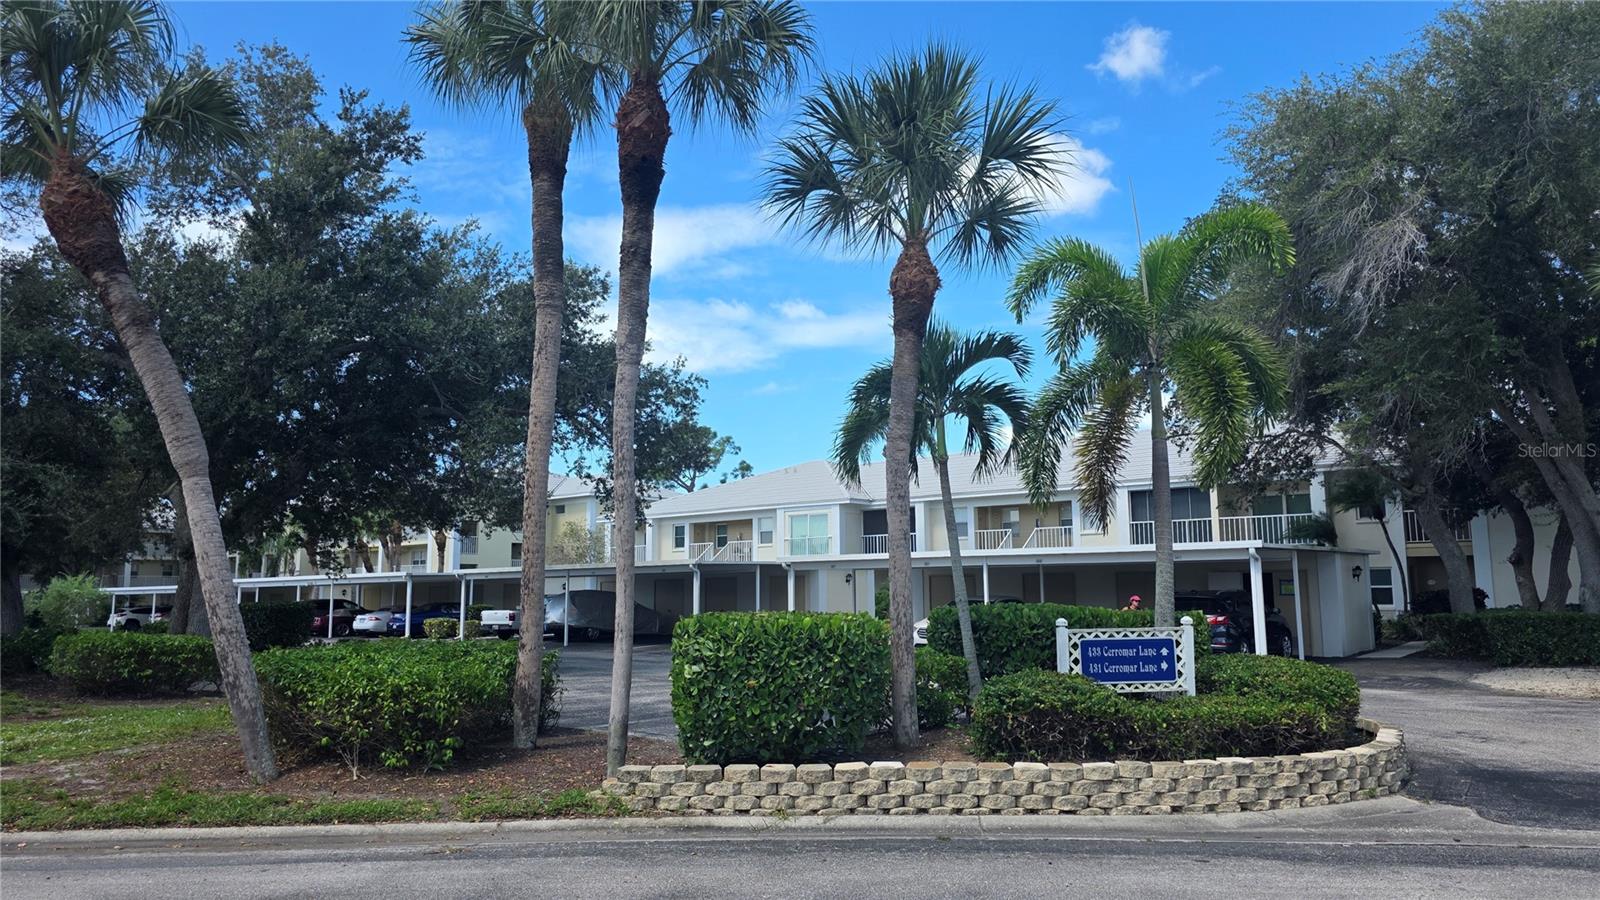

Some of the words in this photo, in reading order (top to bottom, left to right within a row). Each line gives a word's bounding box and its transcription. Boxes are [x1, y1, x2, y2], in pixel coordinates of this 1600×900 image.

[1103, 646, 1136, 658] Cerromar
[1139, 645, 1156, 657] Lane
[1103, 662, 1138, 674] Cerromar
[1139, 661, 1158, 673] Lane
